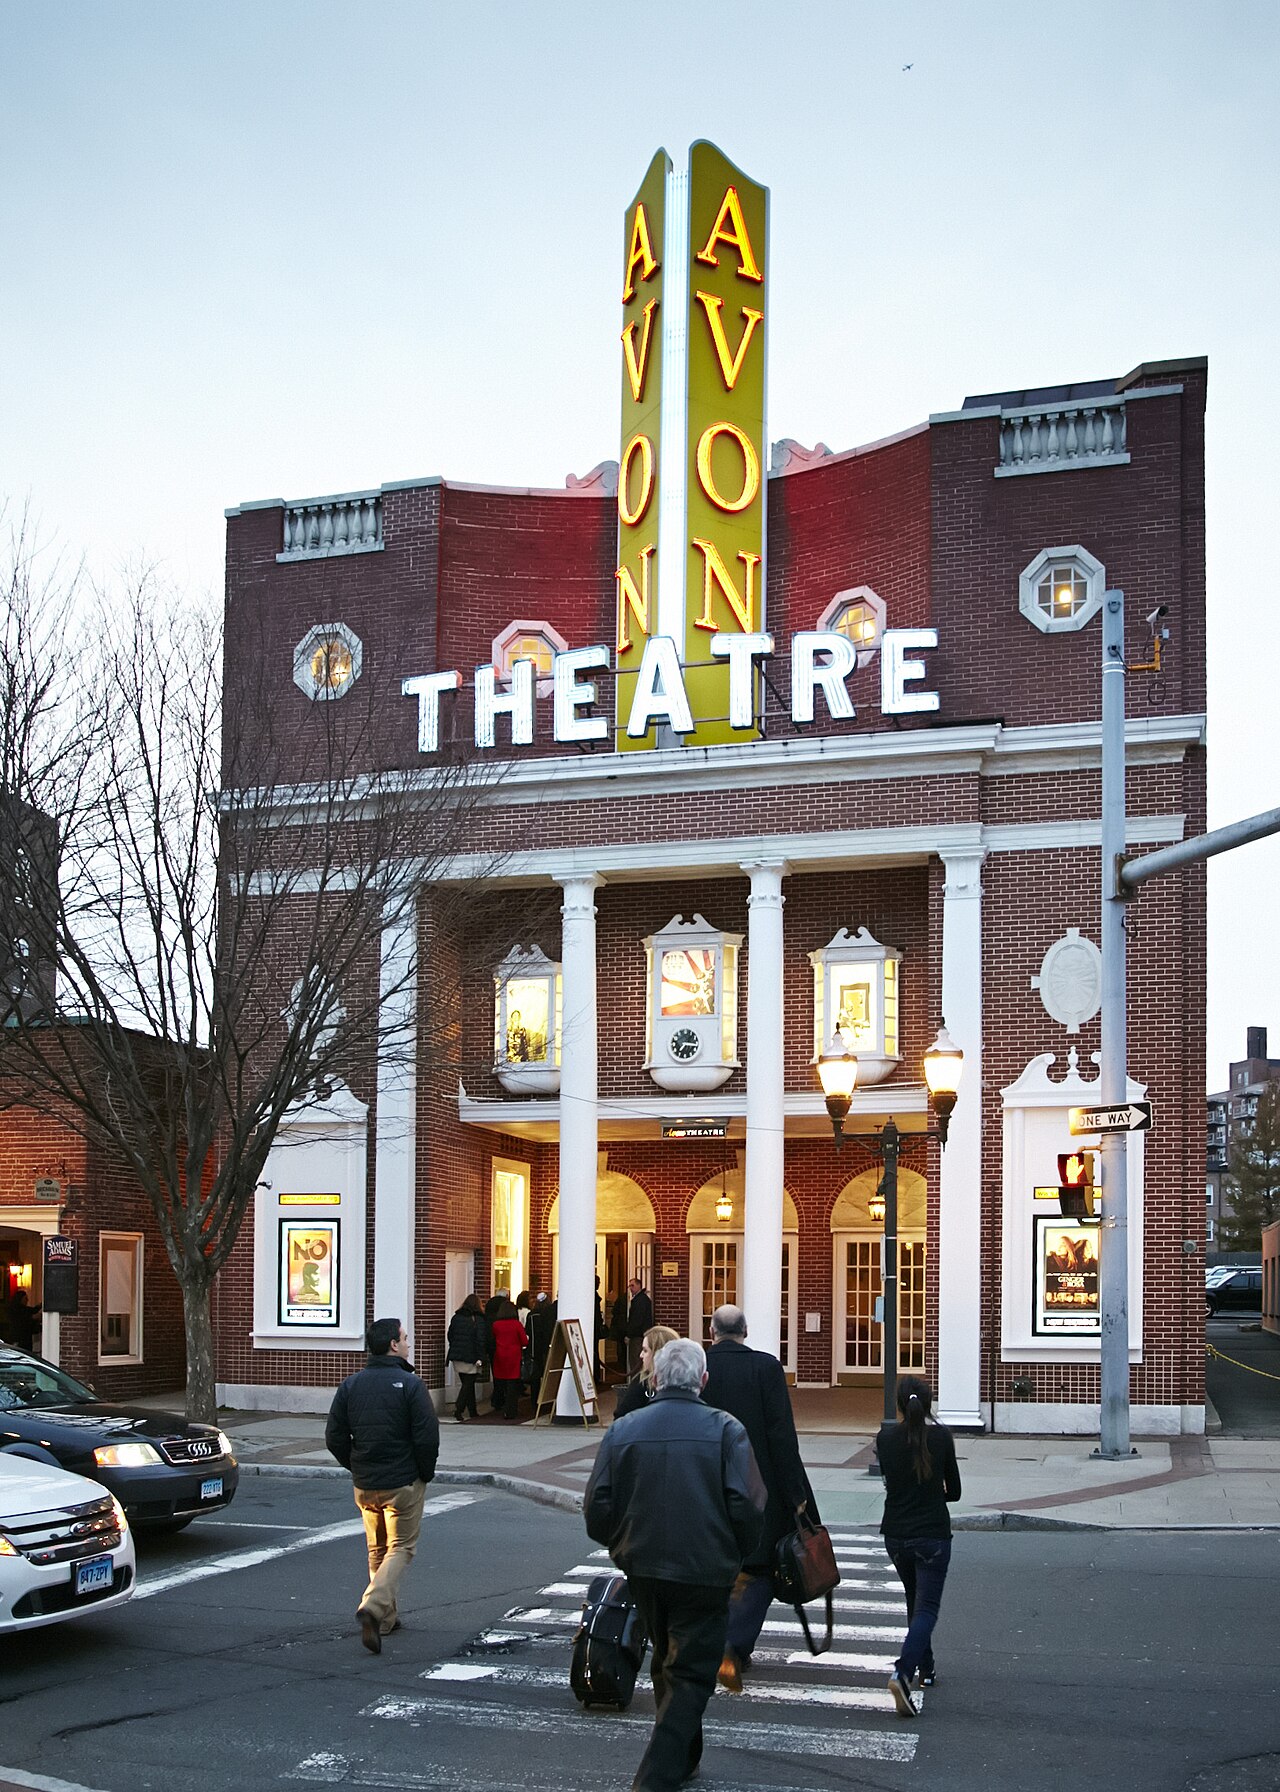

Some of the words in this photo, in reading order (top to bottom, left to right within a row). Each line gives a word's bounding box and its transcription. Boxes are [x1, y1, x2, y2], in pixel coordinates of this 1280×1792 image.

[693, 185, 765, 634] AVON
[616, 201, 661, 655] AVON
[401, 628, 941, 753] THEATRE
[1079, 1115, 1101, 1127] ONE
[1108, 1112, 1132, 1124] WAY
[47, 1240, 74, 1250] SAMUEL
[49, 1248, 72, 1257] ADAMS
[294, 1239, 328, 1261] NO
